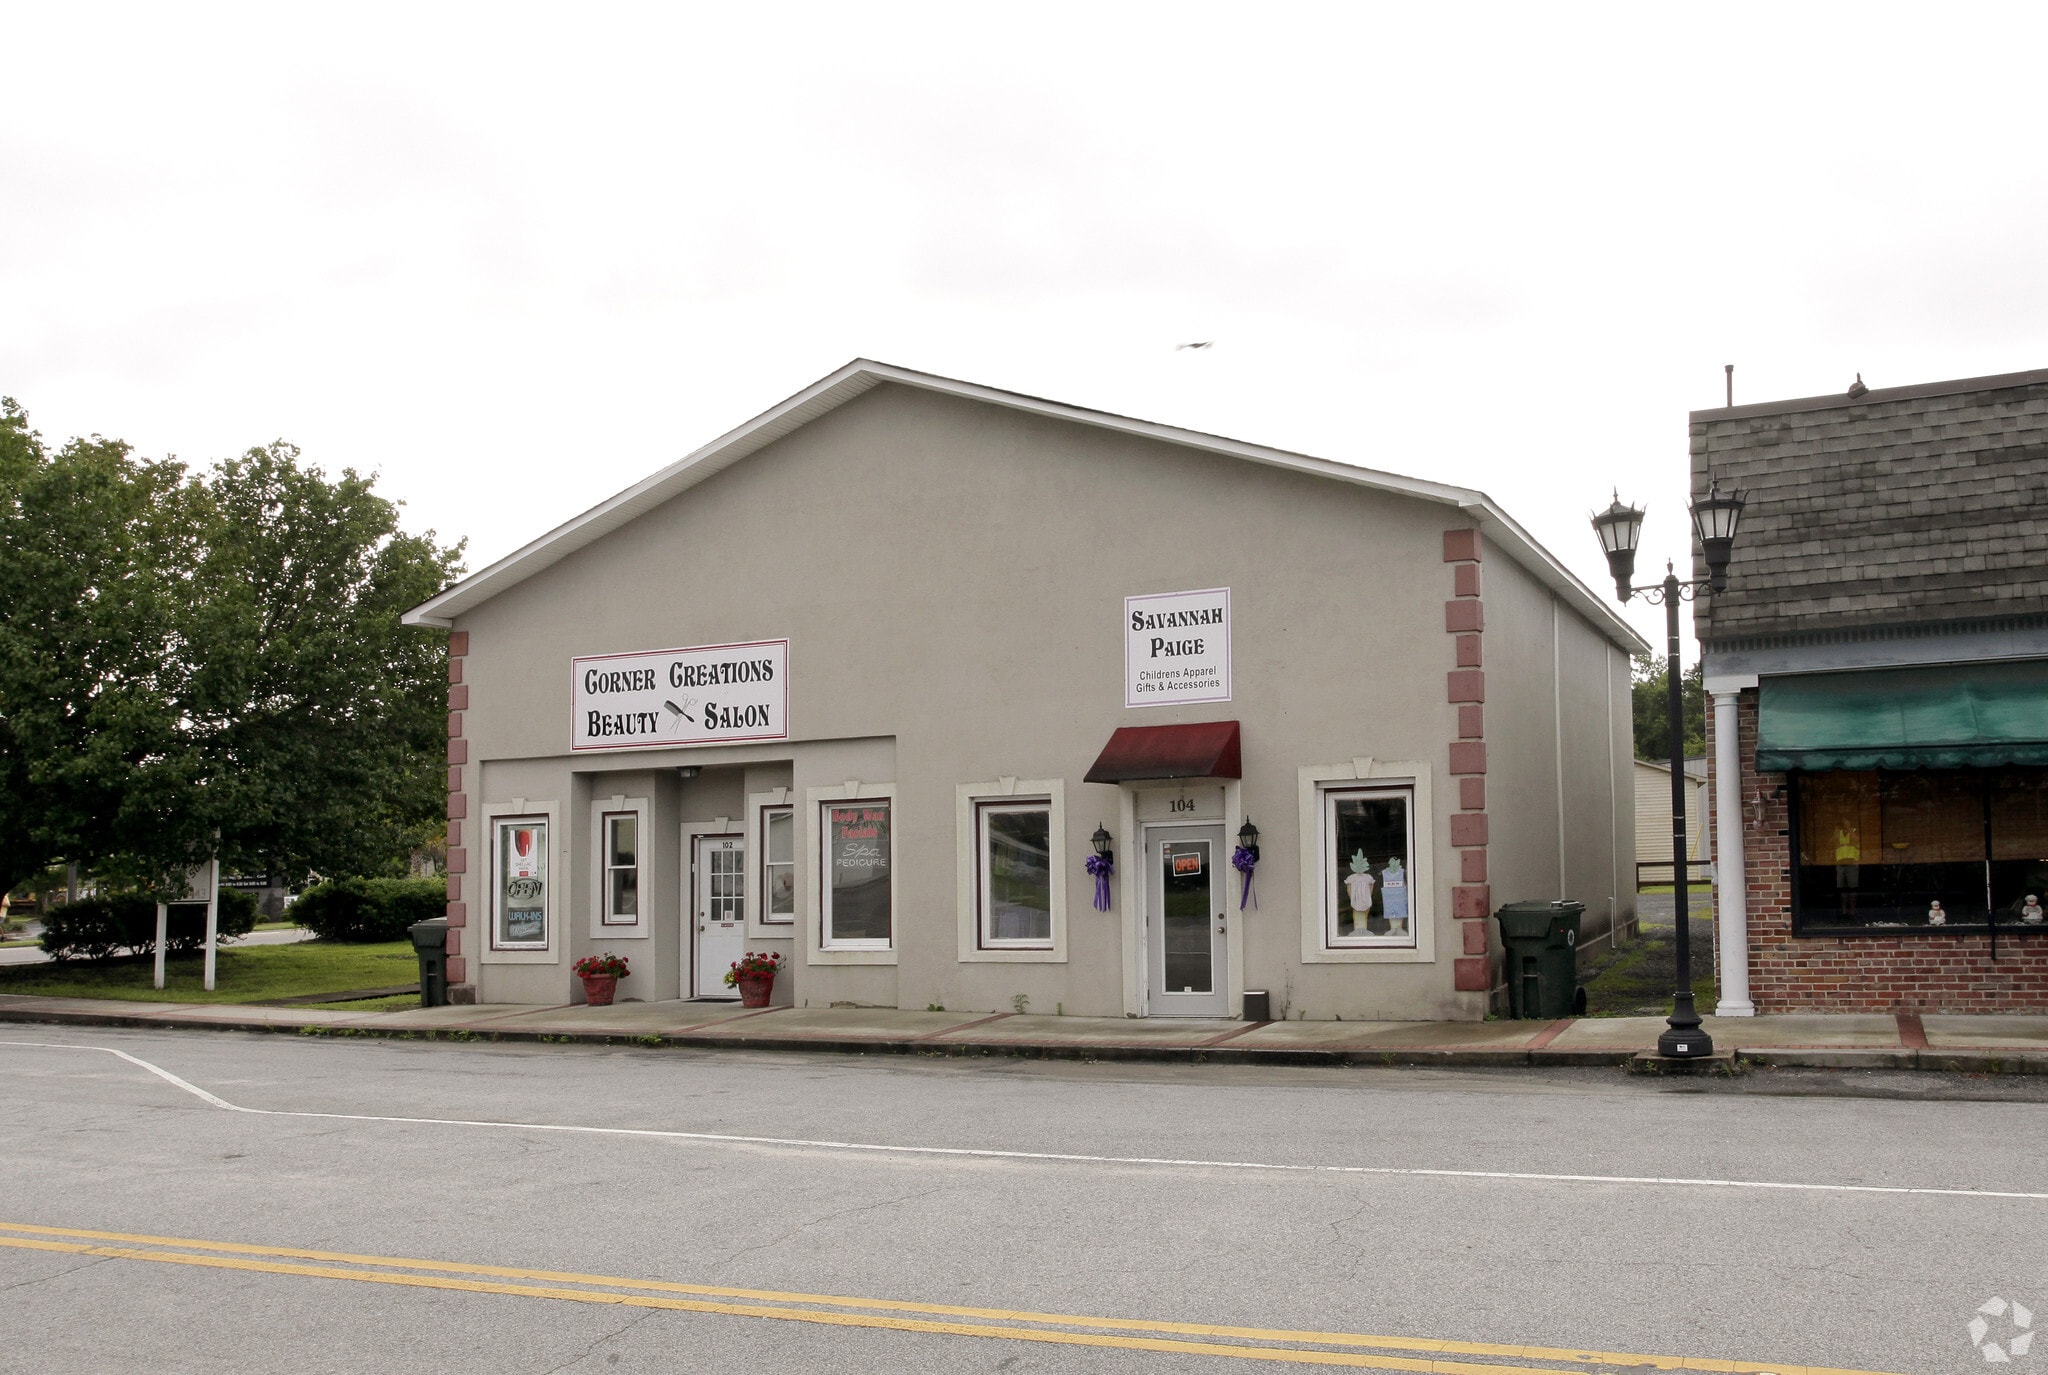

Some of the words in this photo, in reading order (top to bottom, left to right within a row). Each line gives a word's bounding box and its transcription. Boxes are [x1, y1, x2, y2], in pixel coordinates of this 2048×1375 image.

[1131, 608, 1223, 632] SAVANNAH
[1150, 637, 1205, 658] PAIGE
[584, 668, 656, 695] CORNER
[669, 659, 774, 688] CREATIONS
[1139, 669, 1180, 681] Childrens
[1183, 666, 1217, 679] Apparel
[1136, 682, 1156, 693] Gifts
[1158, 681, 1165, 691] &
[1167, 678, 1220, 691] Accessories
[587, 710, 659, 737] BEAUTY
[704, 702, 770, 730] SALON
[1169, 799, 1195, 812] 104
[842, 843, 881, 859] Spa
[836, 858, 887, 867] PEDICURE
[1175, 857, 1199, 872] OPEN
